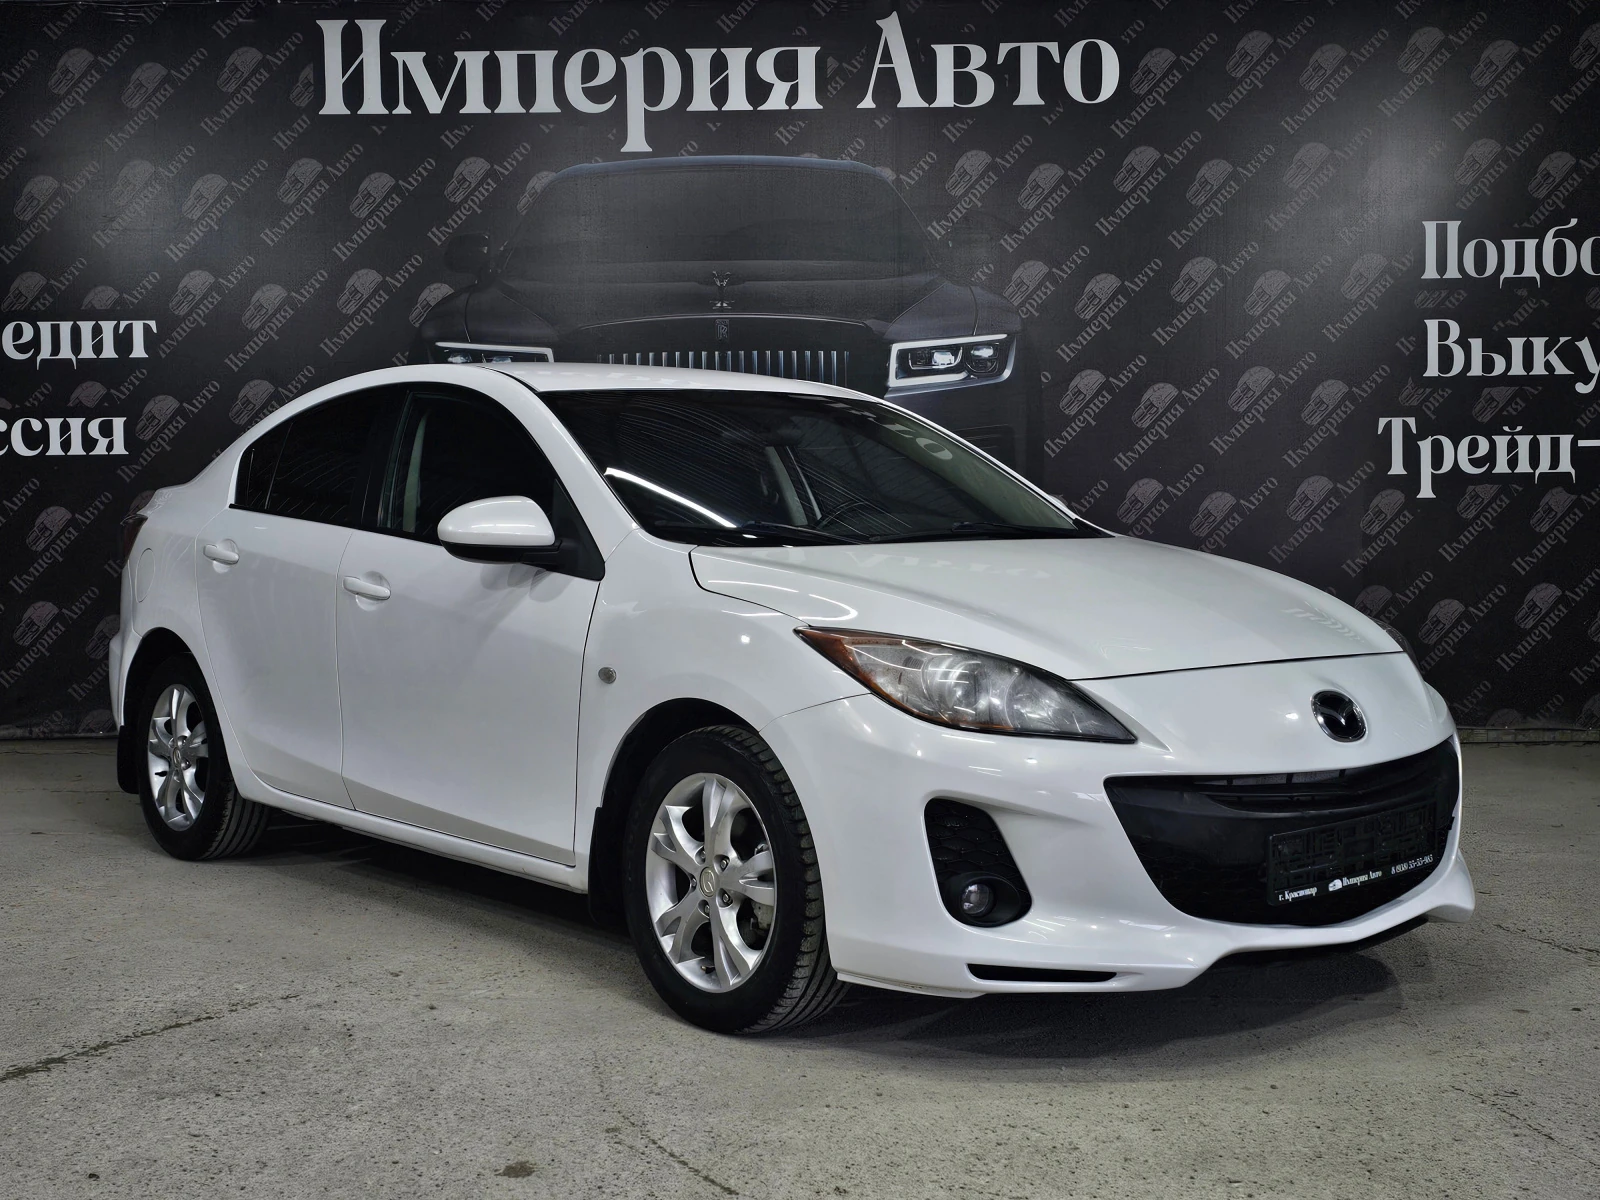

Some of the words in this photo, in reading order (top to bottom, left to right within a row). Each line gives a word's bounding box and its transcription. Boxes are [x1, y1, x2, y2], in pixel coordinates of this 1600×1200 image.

[1, 48, 39, 88] Авто
[31, 68, 102, 138] Империя
[97, 33, 136, 73] Авто
[104, 82, 175, 152] Империя
[170, 47, 209, 86] Авто
[200, 69, 271, 137] Империя
[265, 32, 304, 71] Авто
[316, 19, 824, 152] Империя
[856, 10, 1120, 109] Авто
[1110, 69, 1183, 140] Империя
[1178, 32, 1219, 72] Авто
[1207, 53, 1280, 123] Империя
[1275, 15, 1315, 54] Авто
[1280, 66, 1353, 136] Империя
[1348, 28, 1389, 68] Авто
[1376, 49, 1451, 119] Империя
[1447, 11, 1488, 50] Авто
[1450, 60, 1525, 133] Империя
[1521, 23, 1562, 63] Авто
[156, 144, 196, 182] Авто
[260, 180, 331, 248] Империя
[325, 143, 364, 182] Авто
[427, 178, 497, 248] Империя
[492, 142, 531, 181] Авто
[898, 150, 937, 190] Авто
[926, 171, 999, 242] Империя
[993, 133, 1033, 173] Авто
[1095, 167, 1168, 238] Империя
[1162, 130, 1202, 170] Авто
[1504, 123, 1545, 163] Авто
[0, 195, 66, 265] Империя
[62, 160, 101, 198] Авто
[164, 193, 236, 263] Империя
[230, 158, 269, 197] Авто
[332, 193, 403, 263] Империя
[397, 156, 437, 196] Авто
[998, 184, 1071, 254] Империя
[1066, 147, 1106, 187] Авто
[1167, 180, 1240, 251] Империя
[1235, 144, 1275, 183] Авто
[49, 256, 88, 295] Авто
[122, 270, 160, 308] Авто
[217, 255, 256, 294] Авто
[319, 289, 390, 358] Империя
[385, 253, 423, 293] Авто
[1050, 245, 1090, 284] Авто
[1055, 293, 1128, 364] Империя
[1123, 258, 1163, 297] Авто
[1151, 277, 1225, 348] Империя
[1219, 241, 1260, 280] Авто
[1224, 290, 1297, 360] Империя
[1293, 254, 1333, 292] Авто
[1321, 274, 1394, 344] Империя
[223, 304, 295, 373] Империя
[290, 269, 329, 308] Авто
[110, 367, 148, 404] Авто
[116, 413, 187, 484] Империя
[182, 380, 220, 418] Авто
[277, 365, 316, 402] Авто
[1042, 389, 1112, 459] Империя
[1108, 354, 1148, 392] Авто
[1113, 402, 1185, 472] Империя
[1180, 367, 1220, 406] Авто
[1208, 386, 1282, 456] Империя
[1276, 351, 1317, 390] Авто
[1281, 399, 1355, 470] Империя
[1350, 364, 1391, 403] Авто
[0, 417, 129, 457] сия
[1165, 463, 1205, 502] Авто
[2, 477, 41, 516] Авто
[9, 526, 80, 595] Империя
[74, 491, 113, 529] Авто
[1070, 479, 1109, 514] Авто
[1238, 477, 1279, 516] Авто
[1267, 496, 1340, 565] Империя
[1335, 460, 1376, 499] Авто
[1341, 509, 1414, 579] Империя
[1438, 493, 1510, 564] Империя
[1511, 507, 1585, 577] Империя
[0, 621, 66, 690] Империя
[61, 586, 100, 624] Авто
[1393, 570, 1434, 609] Авто
[1466, 583, 1507, 623] Авто
[1495, 604, 1568, 674] Империя
[1563, 567, 1600, 607] Авто
[1452, 680, 1491, 716] Авто
